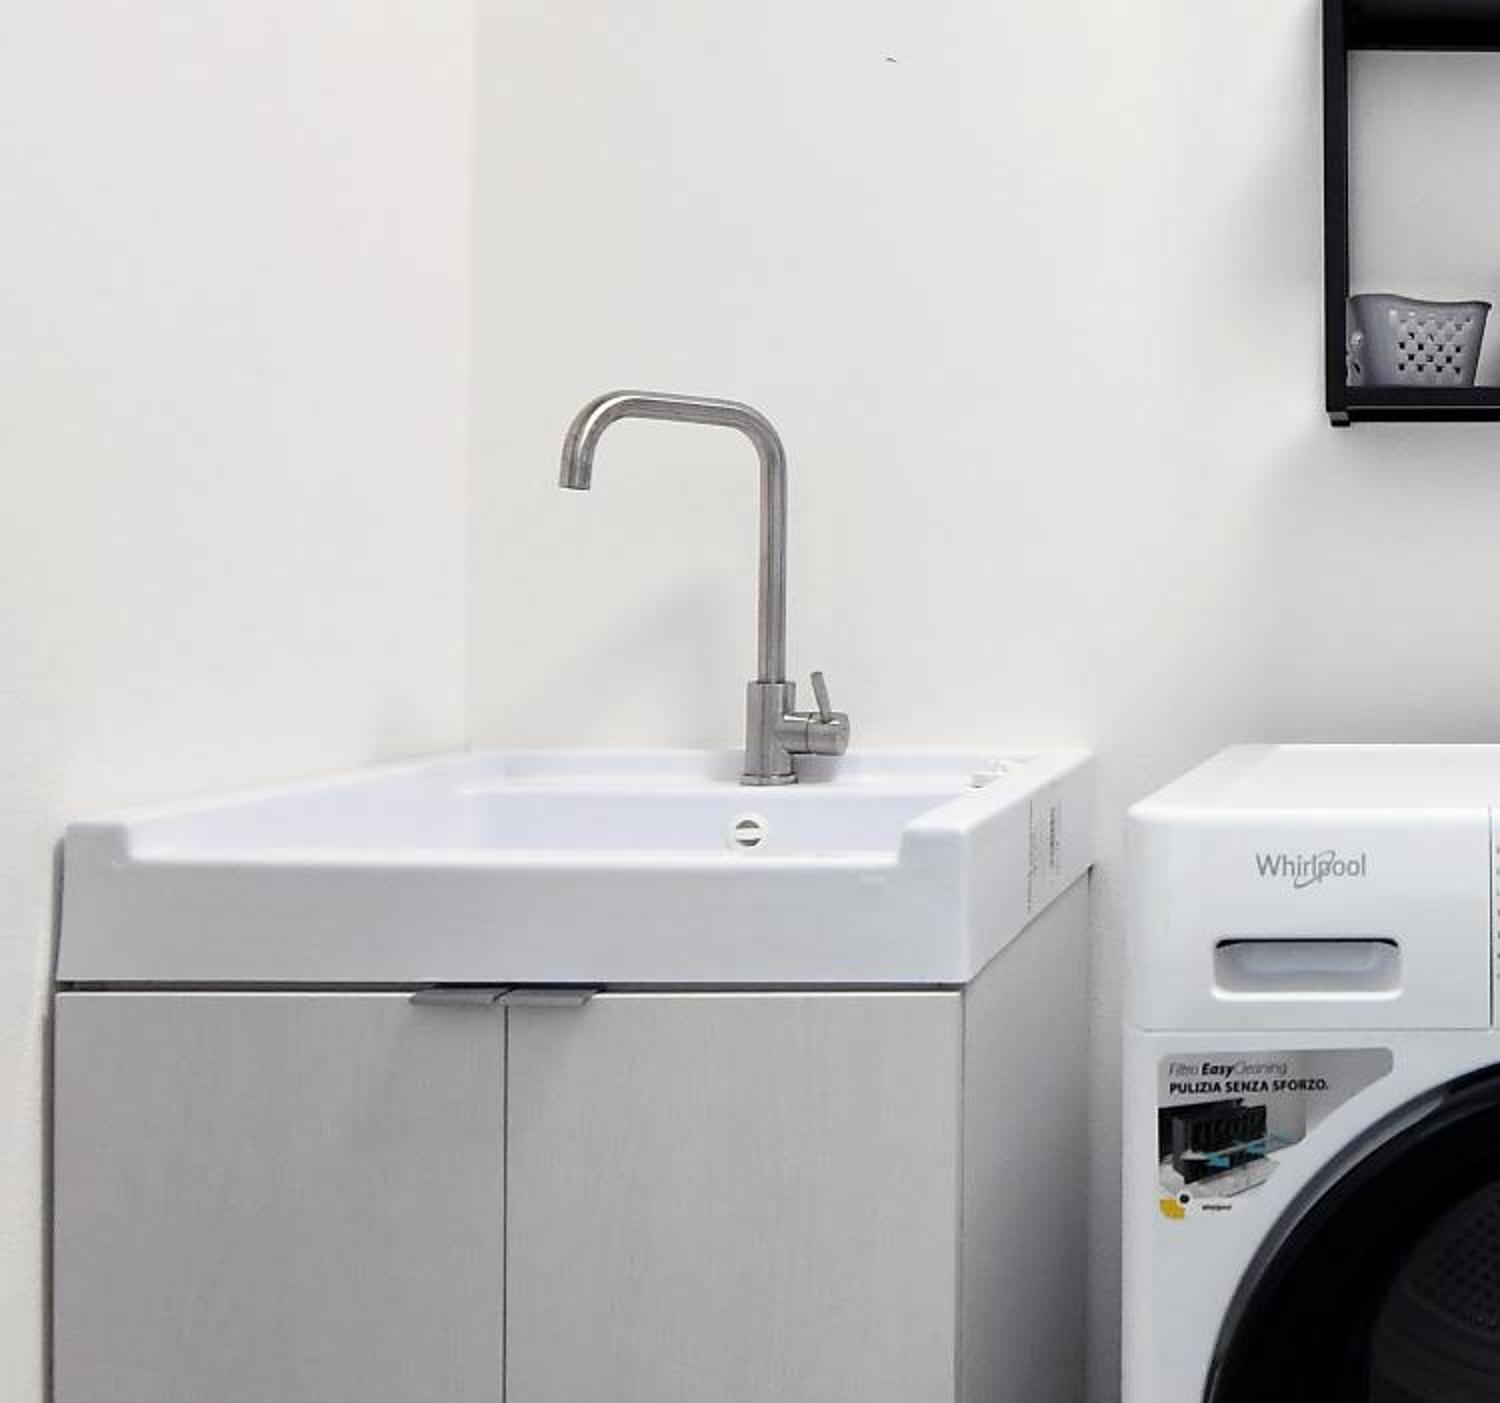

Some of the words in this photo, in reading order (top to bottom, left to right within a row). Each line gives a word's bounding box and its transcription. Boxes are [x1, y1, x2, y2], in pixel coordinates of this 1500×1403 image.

[1256, 851, 1366, 888] Whirlpool
[1169, 1062, 1200, 1076] Filtro
[1169, 1081, 1223, 1095] PULIZIA
[1225, 1080, 1270, 1093] SENZA
[1273, 1078, 1329, 1092] SFORZO.
